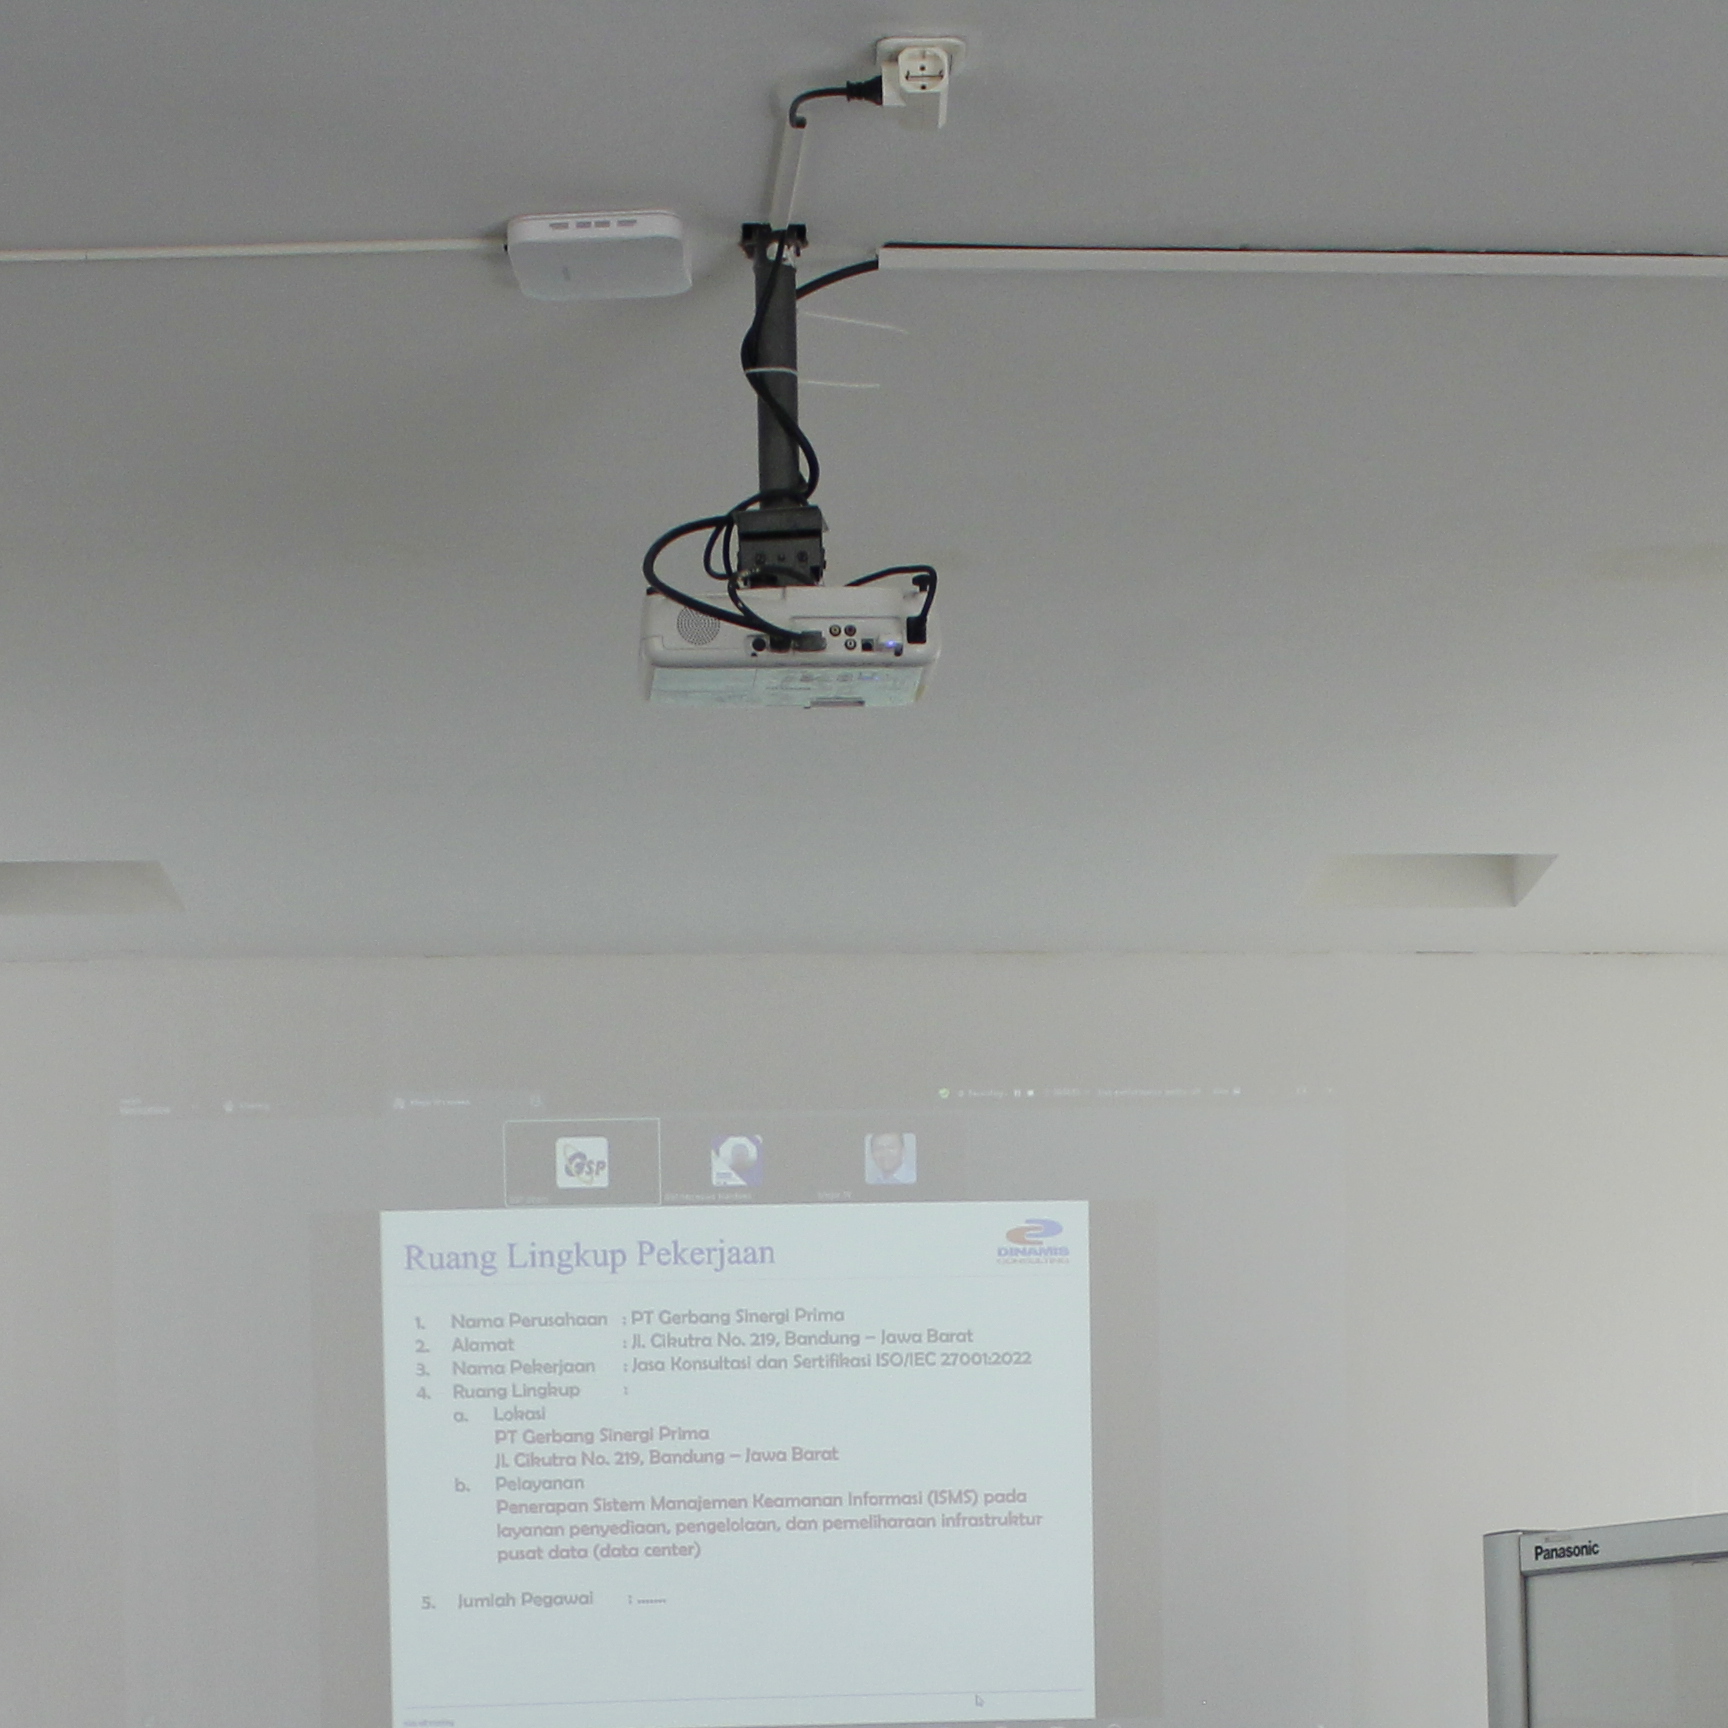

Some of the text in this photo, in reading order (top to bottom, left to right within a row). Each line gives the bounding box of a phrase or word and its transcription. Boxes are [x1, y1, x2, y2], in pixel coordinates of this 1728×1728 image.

[405, 1238, 776, 1276] Ruang Lingkup Pekerjaan
[997, 1247, 1070, 1257] DINAMIS
[414, 1316, 426, 1330] 1.
[450, 1313, 505, 1330] Nama
[508, 1311, 608, 1328] Perusahaan
[630, 1309, 655, 1326] PT
[657, 1308, 731, 1326] Gerbang
[735, 1308, 790, 1326] Sinergi
[794, 1306, 845, 1322] Prima
[415, 1338, 431, 1354] 2.
[451, 1336, 515, 1353] Alamat
[631, 1333, 646, 1350] Jl.
[649, 1332, 713, 1349] Cikutra
[717, 1331, 746, 1347] No.
[749, 1332, 781, 1348] 219,
[784, 1329, 861, 1347] Bandung
[880, 1328, 923, 1346] Jawa
[926, 1327, 974, 1344] Barat
[416, 1362, 431, 1377] 3.
[452, 1360, 506, 1376] Nama
[509, 1357, 596, 1377] Pekerjaan
[631, 1356, 666, 1374] Jasa
[670, 1355, 752, 1372] Konsultasi
[755, 1354, 789, 1370] dan
[793, 1352, 872, 1370] Sertifikasi
[875, 1350, 937, 1368] ISO/IEC
[940, 1350, 1033, 1367] 27001:2022
[415, 1386, 432, 1400] 4.
[452, 1383, 508, 1401] Ruang
[511, 1381, 581, 1400] Lingkup
[452, 1404, 546, 1423] a. Lokasi
[494, 1425, 710, 1445] PT Gerbang Sinergi Prima
[494, 1452, 510, 1470] Jl.
[513, 1451, 577, 1468] Cikutra
[581, 1450, 611, 1466] No.
[613, 1450, 645, 1467] 219,
[648, 1448, 725, 1466] Bandung
[744, 1447, 787, 1464] Jawa
[791, 1446, 840, 1462] Barat
[454, 1475, 585, 1494] b. Pelayanan
[496, 1487, 1028, 1516] Penerapan Sistem Manajemen Keamanan Informasi (ISMS) pada
[496, 1510, 1044, 1540] layanan penyediaan, pengelolaan, dan pemeliharaan infrastruktur
[497, 1540, 702, 1564] pusat data (data center)
[1534, 1540, 1600, 1561] Panasonic
[421, 1595, 437, 1610] 5.
[457, 1592, 517, 1610] Jumlah
[520, 1590, 594, 1609] Pegawai
